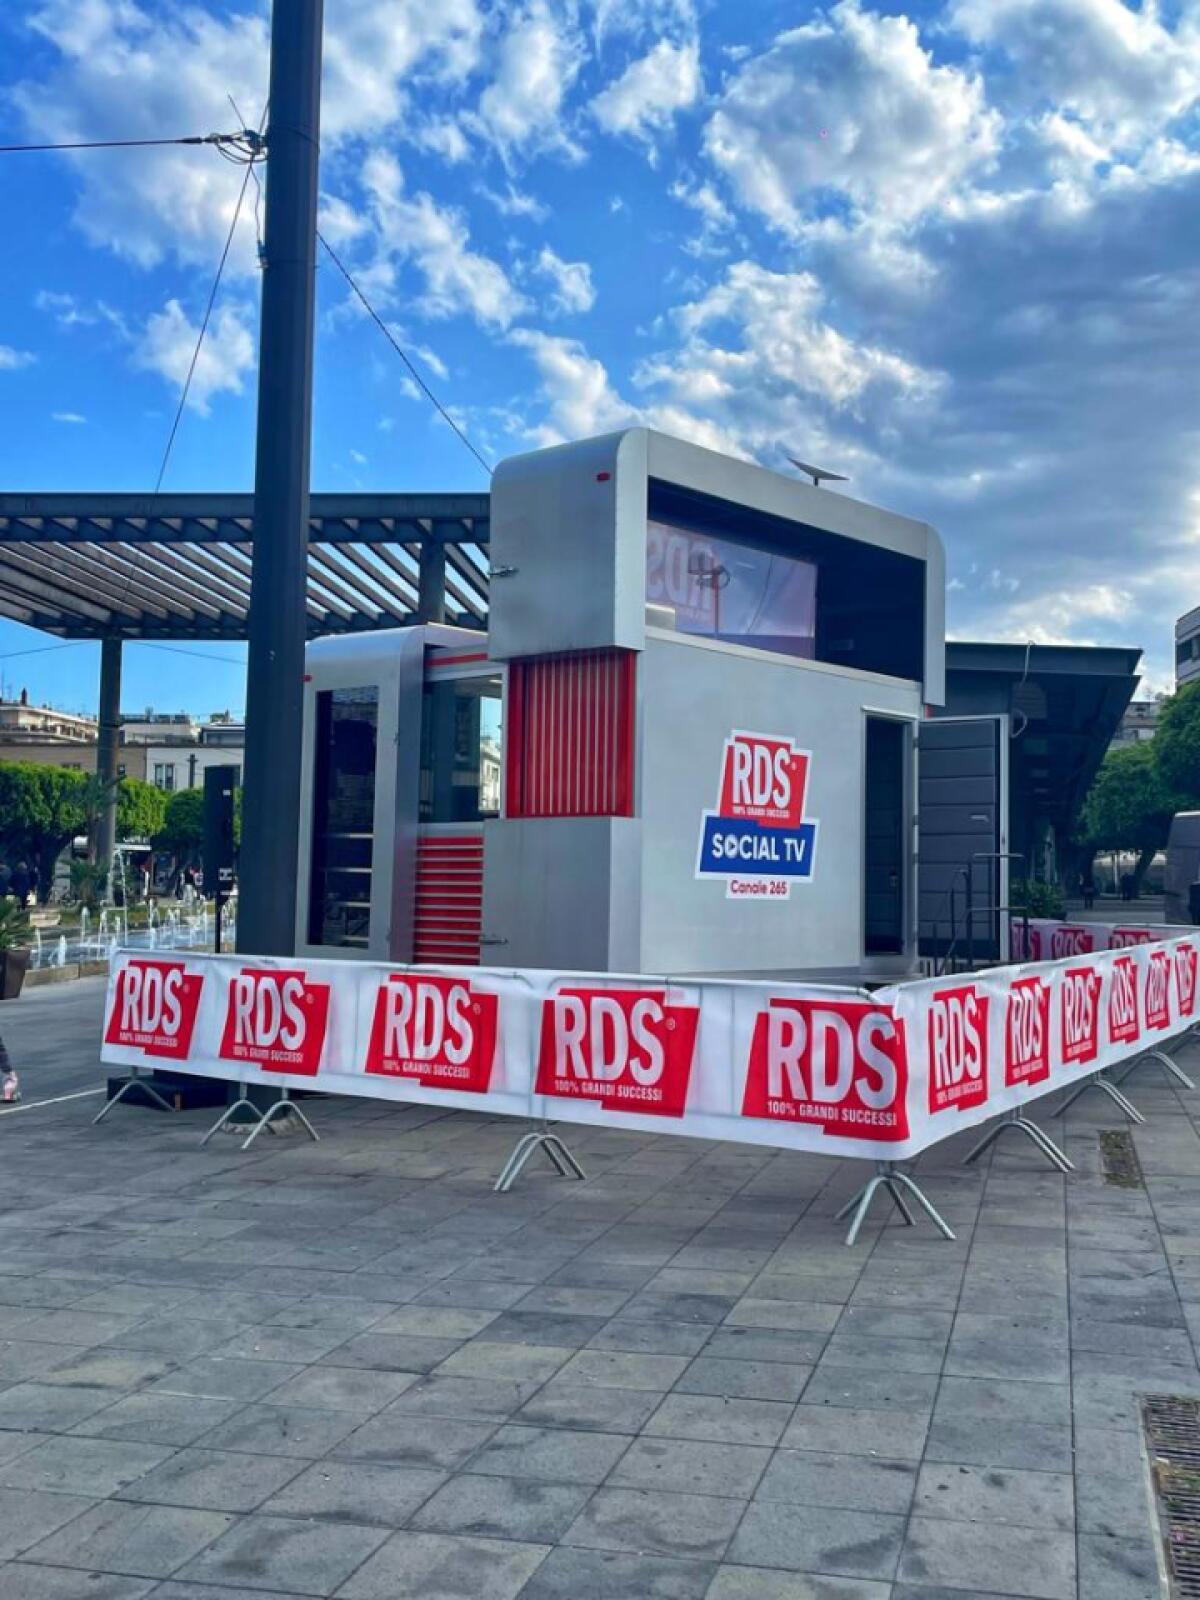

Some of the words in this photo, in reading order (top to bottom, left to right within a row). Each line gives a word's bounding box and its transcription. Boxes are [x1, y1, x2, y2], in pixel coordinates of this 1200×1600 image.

[732, 741, 791, 809] RDS
[712, 833, 780, 861] SOCIAL
[783, 838, 806, 863] TV
[730, 880, 767, 894] Canale
[769, 881, 788, 895] 265
[121, 966, 182, 1036] RDS
[235, 975, 305, 1050] RDS
[384, 980, 474, 1064] RDS
[1009, 983, 1043, 1066] RDS
[1064, 972, 1094, 1045] RDS
[555, 995, 664, 1086] RDS
[768, 1007, 898, 1110] RDS
[932, 993, 981, 1089] RDS
[555, 1080, 579, 1093] 100%
[582, 1082, 615, 1097] GRANDI
[768, 1101, 795, 1116] 100%
[800, 1104, 838, 1121] GRANDI
[842, 1108, 897, 1126] SUCCESSI
